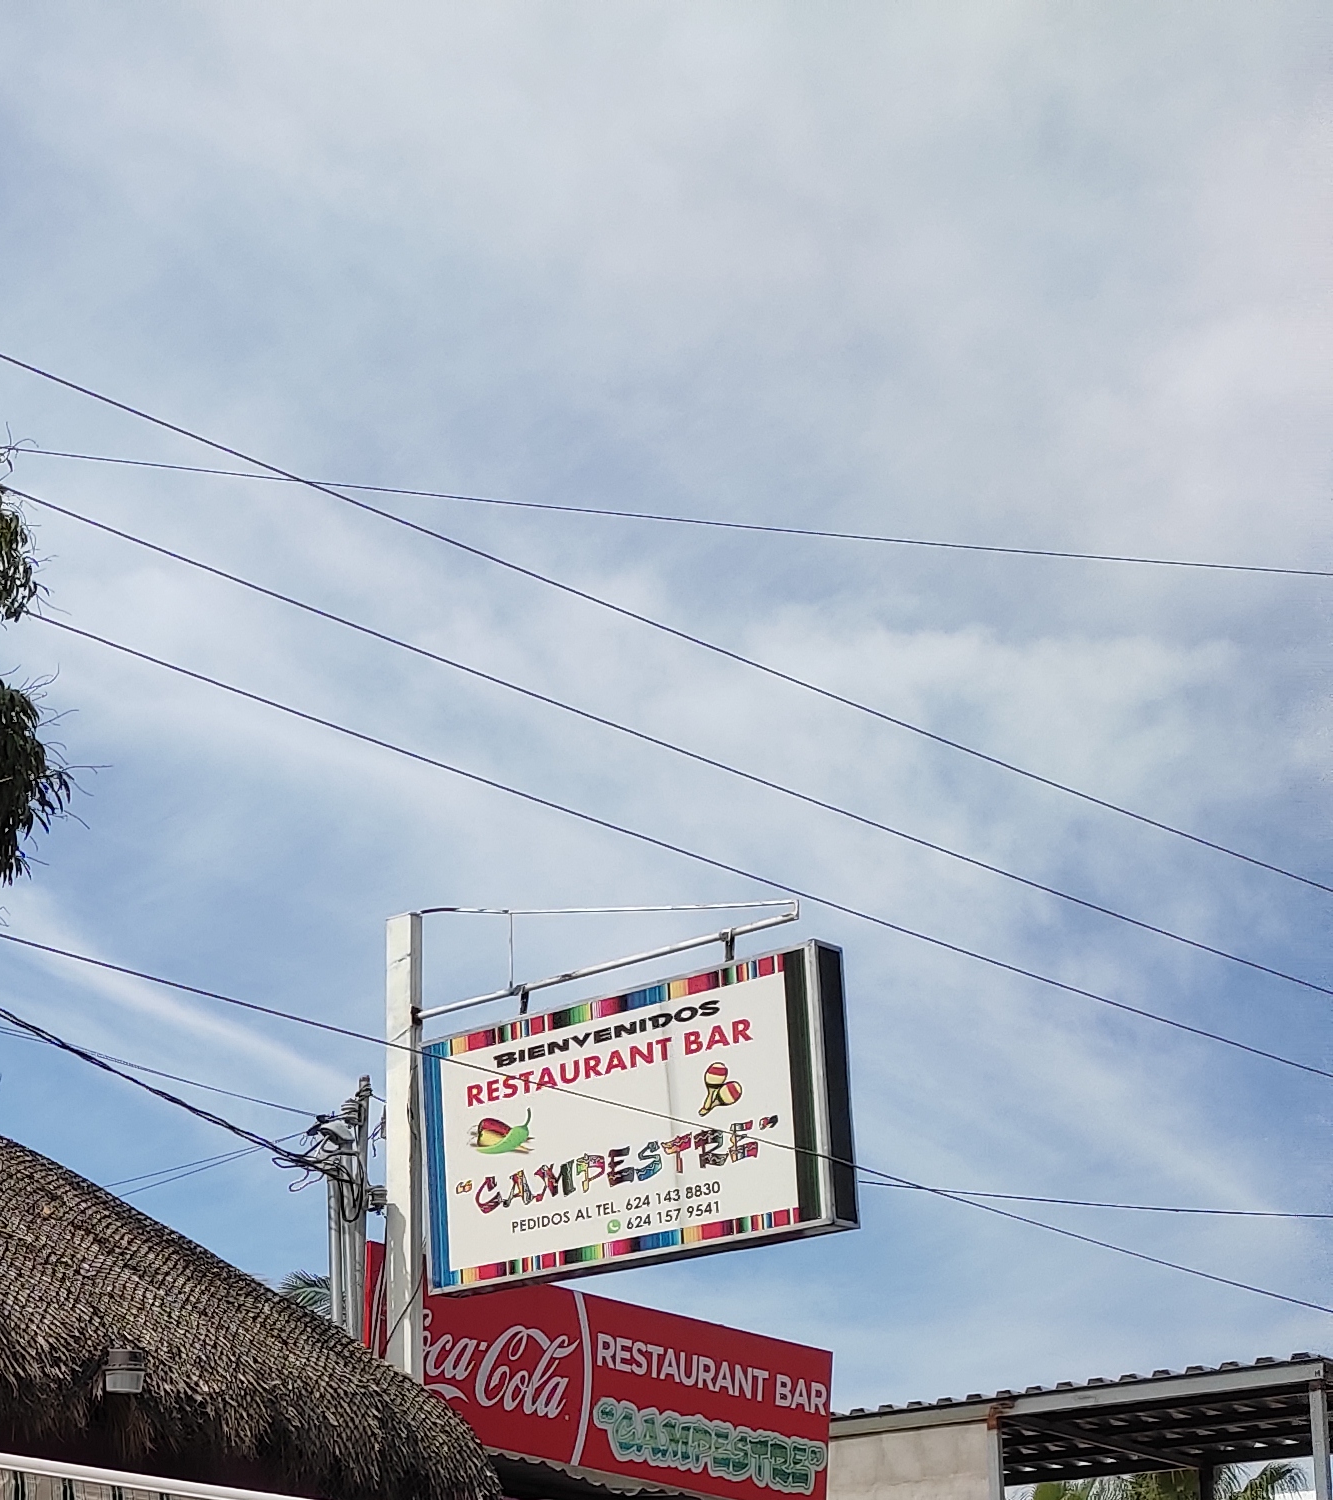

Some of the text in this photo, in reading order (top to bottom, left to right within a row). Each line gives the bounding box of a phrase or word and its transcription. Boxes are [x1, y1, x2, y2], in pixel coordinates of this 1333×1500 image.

[466, 1018, 753, 1107] RESTAURANT BAR
[493, 1000, 721, 1068] BIENVENIDOS
[512, 1181, 721, 1234] PEDIDOS AL TEL. 624 143 8830
[626, 1200, 721, 1231] 624 157 9541
[596, 1333, 827, 1416] RESTAURANT BAR
